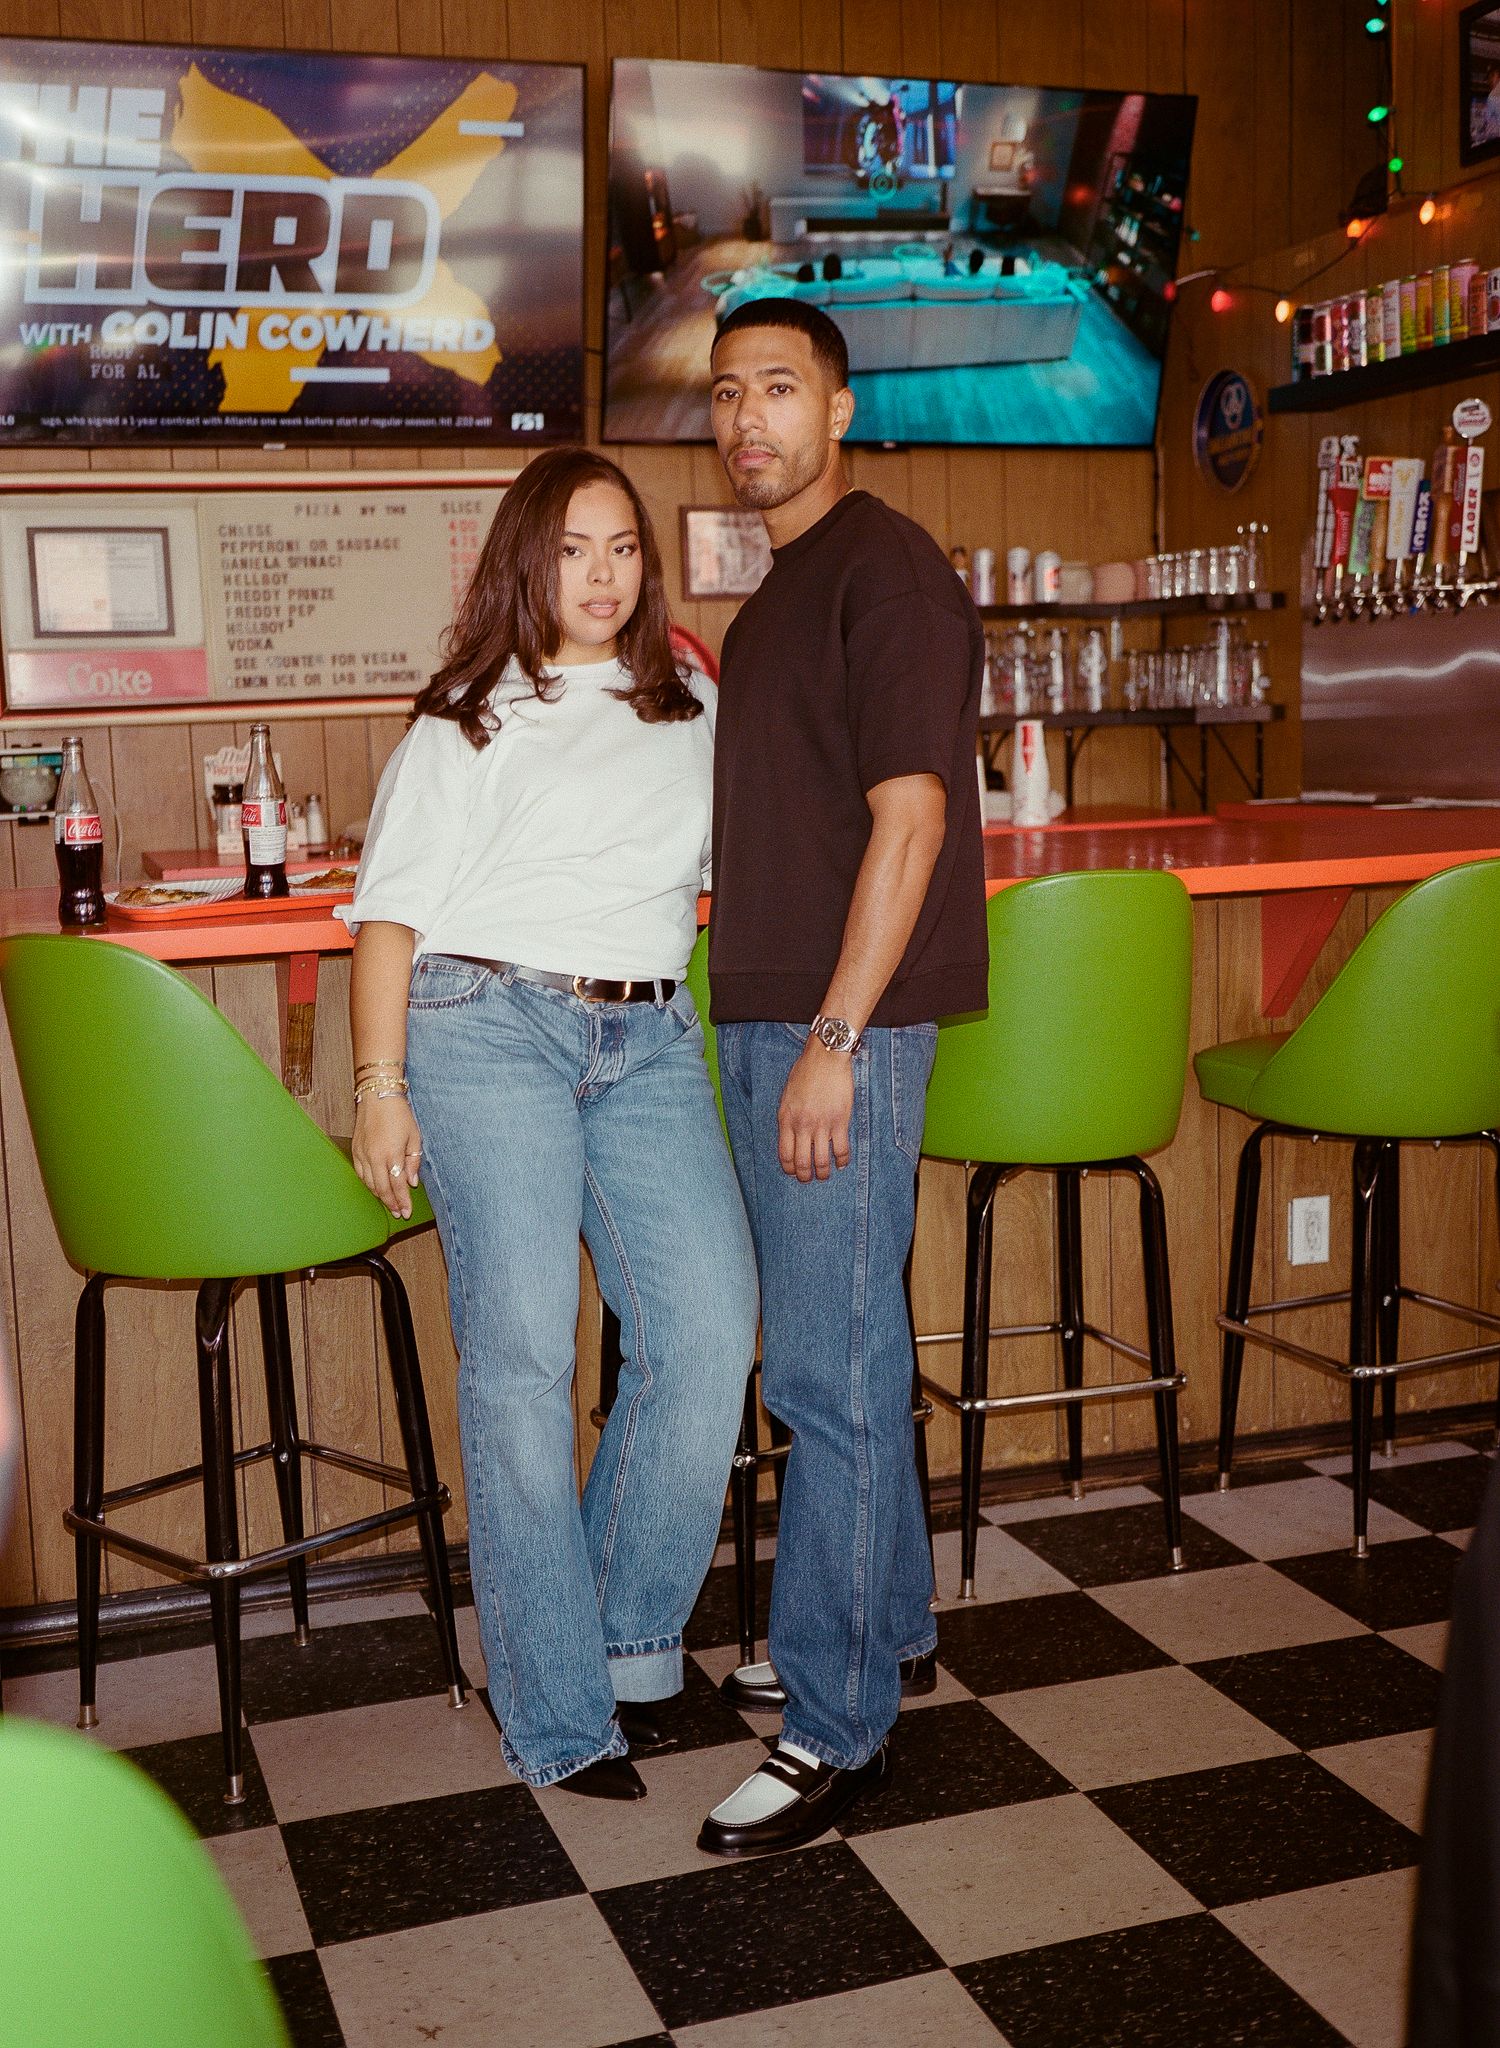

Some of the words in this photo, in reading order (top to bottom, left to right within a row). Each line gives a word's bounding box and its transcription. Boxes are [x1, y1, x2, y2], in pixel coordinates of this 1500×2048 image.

[0, 83, 165, 168] THE
[24, 168, 441, 308] HERD
[20, 323, 92, 345] WITH
[101, 311, 249, 350] COLIN
[258, 313, 496, 353] COWHERD
[91, 363, 126, 379] FOR
[136, 363, 161, 379] AL
[511, 412, 545, 432] FS1
[1464, 488, 1479, 545] LAGER
[218, 524, 272, 538] CHEESE
[220, 538, 300, 553] PEPPERONI
[309, 538, 328, 551] OR
[336, 537, 401, 551] SAUSAGE
[223, 572, 289, 587] HELLBOY
[224, 588, 281, 602] FREDDY
[225, 604, 281, 619] FREDDY
[288, 604, 316, 618] PEP
[227, 637, 273, 652] VODKA
[234, 656, 257, 670] SEE
[331, 652, 356, 666] FOR
[362, 651, 408, 665] VEGAN
[66, 660, 153, 697] Coke
[303, 672, 322, 687] OR
